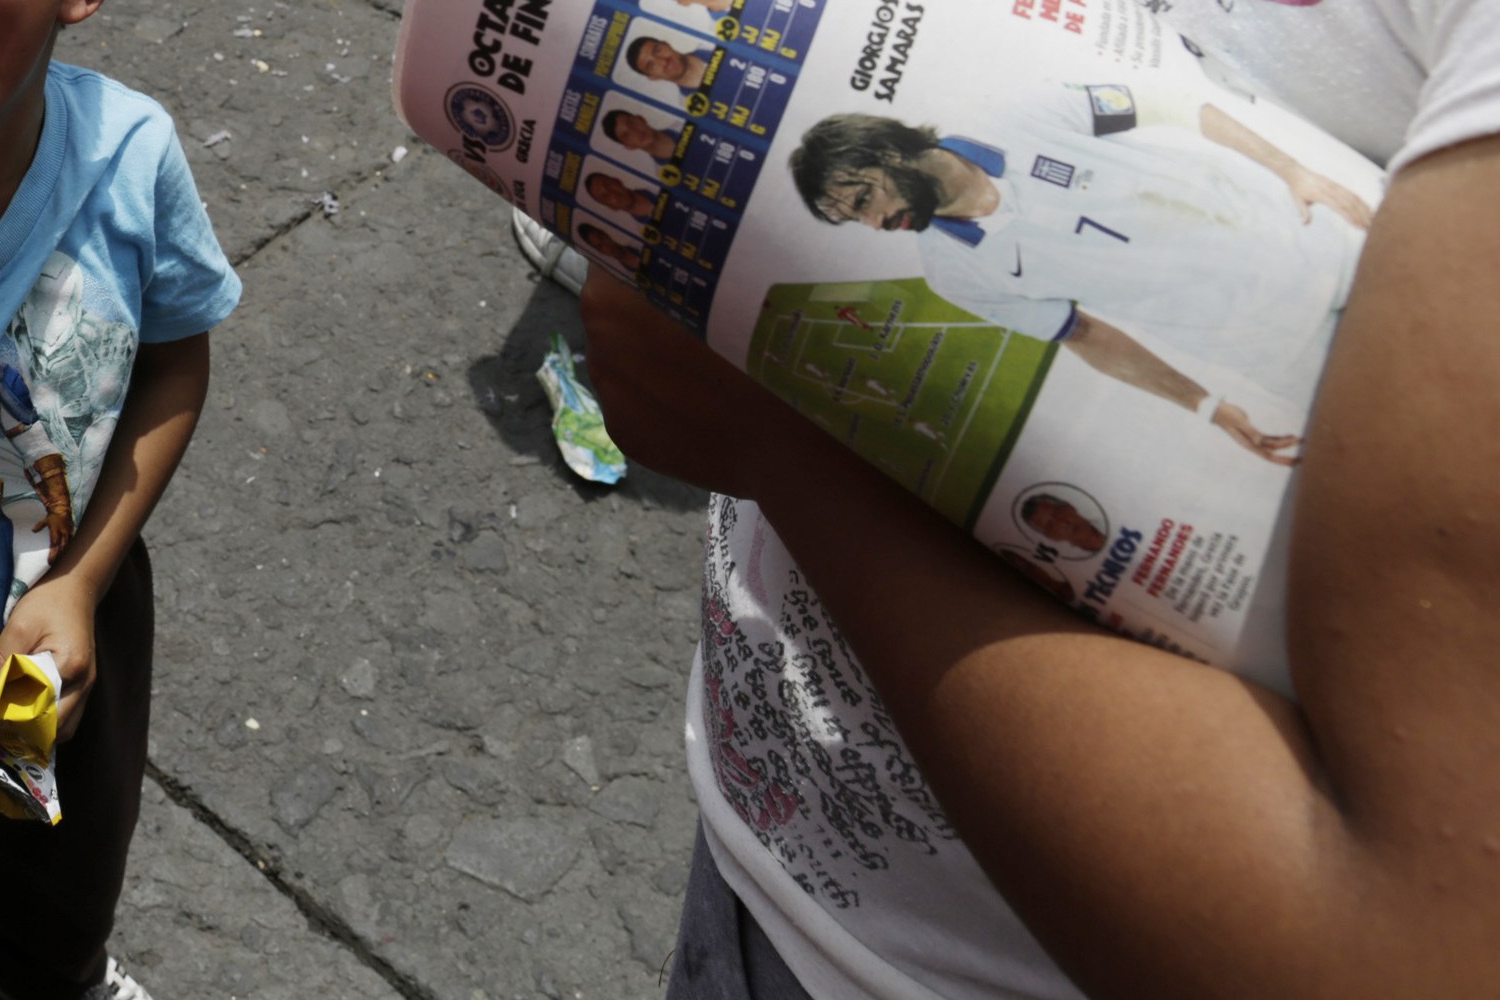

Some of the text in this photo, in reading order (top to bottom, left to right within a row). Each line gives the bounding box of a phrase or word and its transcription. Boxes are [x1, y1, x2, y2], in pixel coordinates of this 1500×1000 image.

[717, 18, 737, 41] 20
[739, 23, 760, 45] JJ
[1064, 10, 1085, 34] DE
[759, 27, 781, 52] MJ
[873, 1, 924, 103] SAMARAS
[496, 51, 533, 94] DE
[709, 57, 747, 120] JJ 2
[728, 104, 751, 128] MJ
[463, 135, 487, 162] VS
[515, 117, 536, 163] GRECIA
[699, 132, 716, 145] 2
[1074, 215, 1129, 243] 7
[1031, 540, 1060, 567] VS
[1131, 516, 1174, 585] FERNANDO
[1146, 522, 1193, 598] FERNANDES
[1084, 525, 1143, 605] TÉCNICOS
